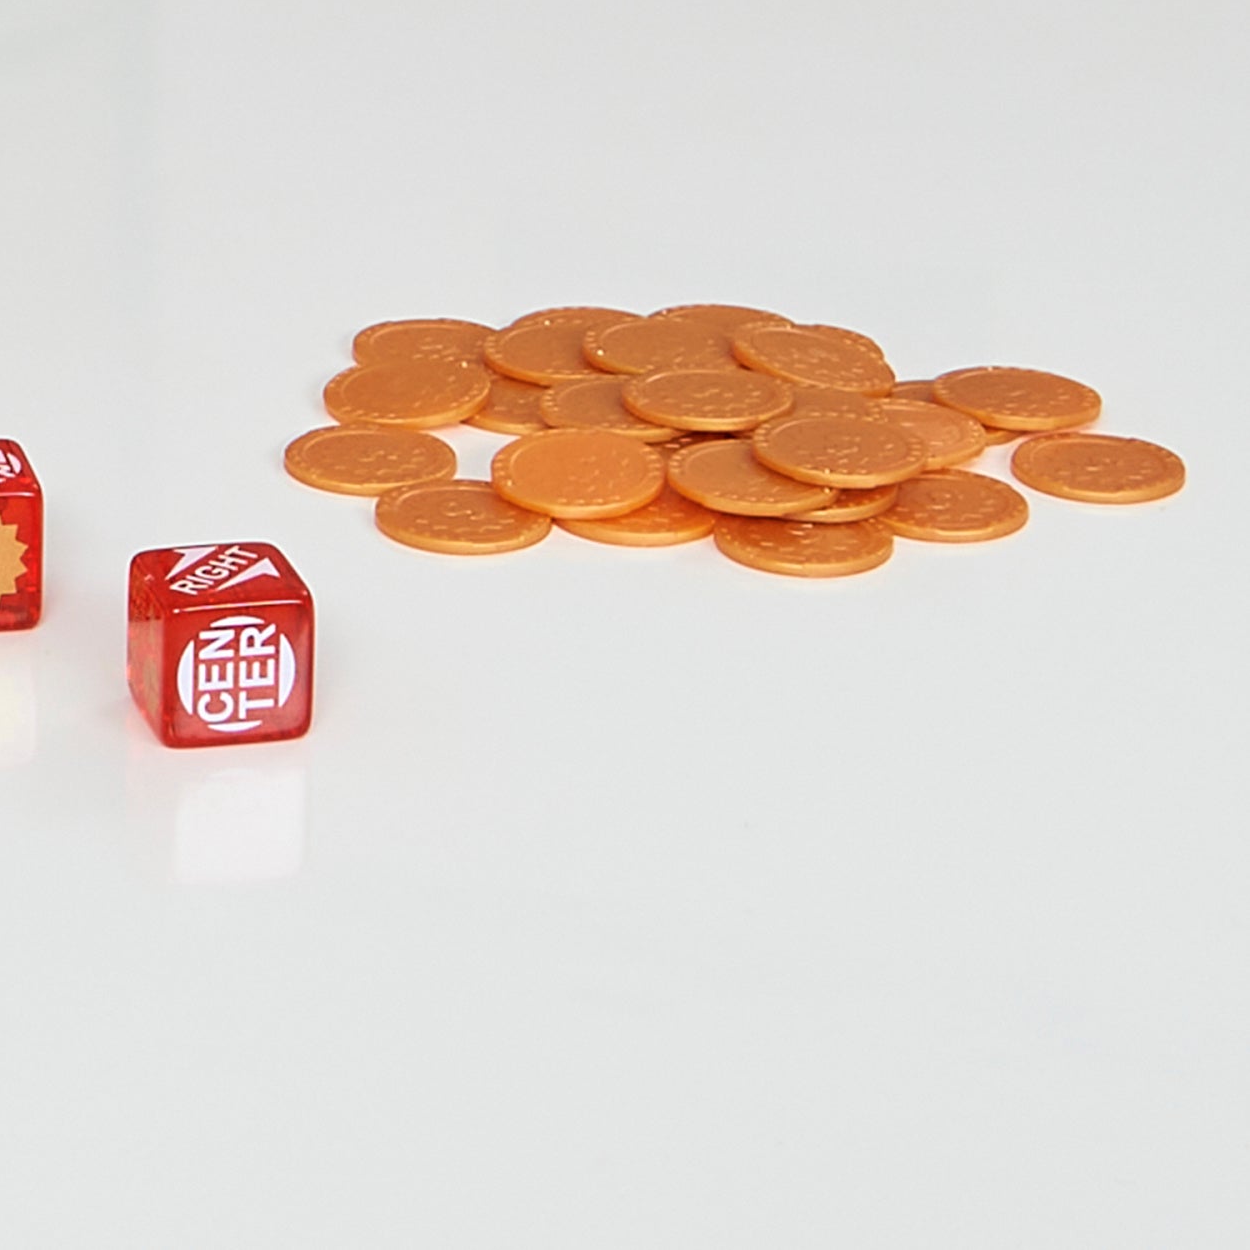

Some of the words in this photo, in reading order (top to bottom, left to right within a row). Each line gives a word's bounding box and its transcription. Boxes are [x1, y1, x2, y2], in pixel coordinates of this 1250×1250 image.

[168, 545, 259, 596] RIGHT
[196, 628, 236, 724] CEN
[237, 623, 277, 720] TER
